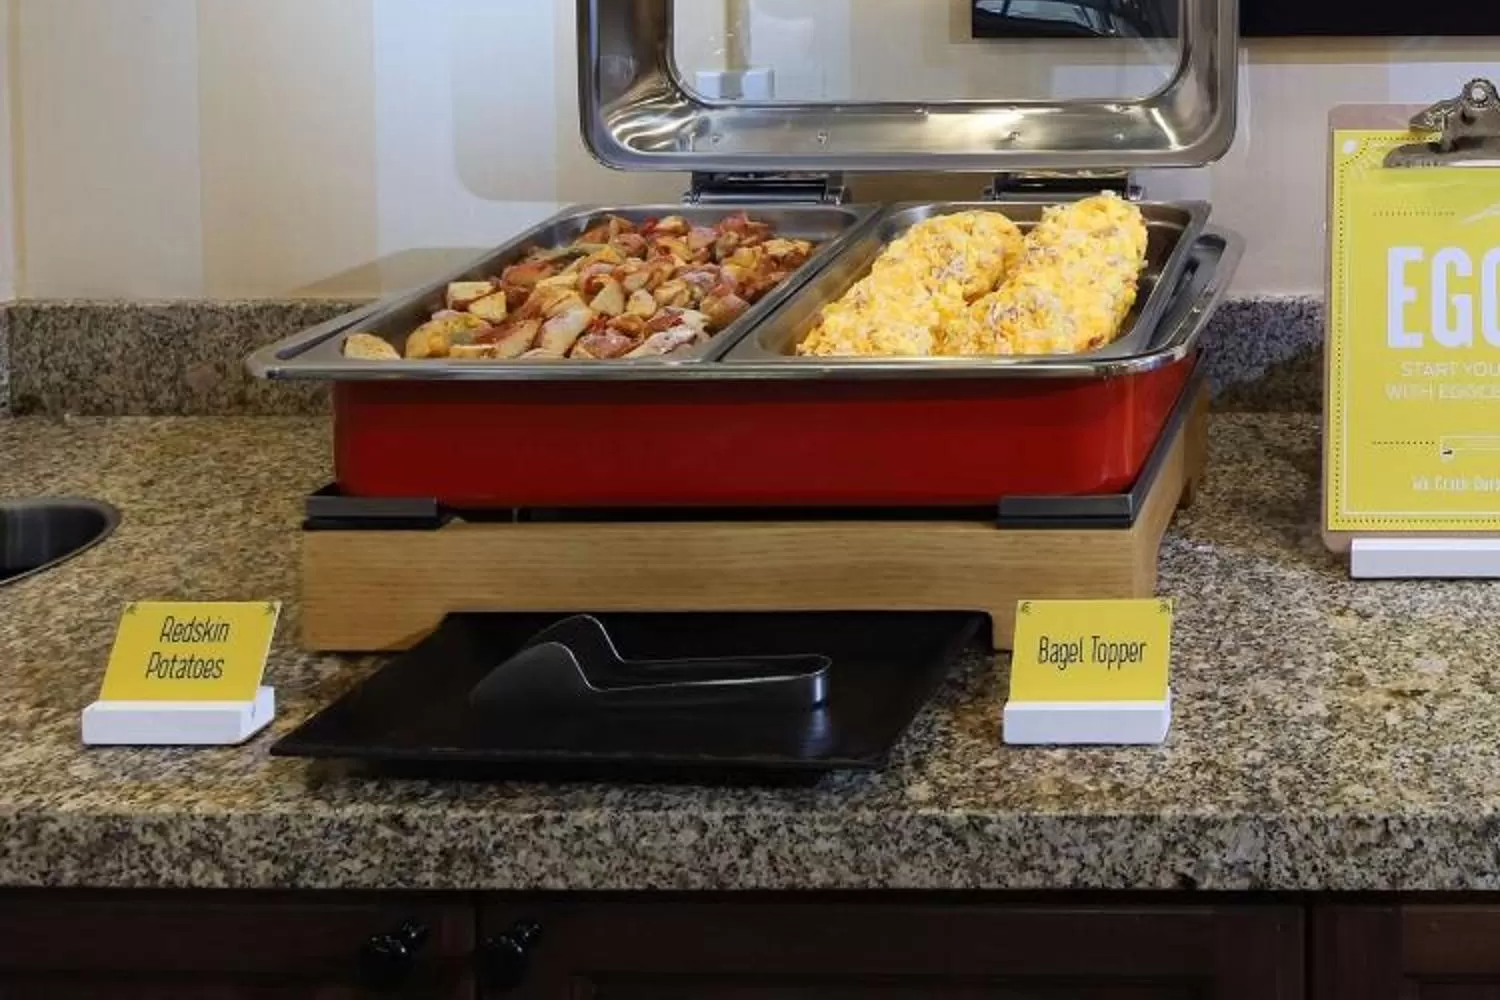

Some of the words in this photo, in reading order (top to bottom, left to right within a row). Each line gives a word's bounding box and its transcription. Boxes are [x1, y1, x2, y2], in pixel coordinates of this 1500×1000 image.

[1401, 360, 1457, 377] START
[1385, 383, 1433, 400] WITH
[159, 615, 230, 643] Redskin
[145, 651, 225, 679] Potatoes
[1037, 635, 1084, 670] Bagel
[1091, 635, 1147, 670] Topper
